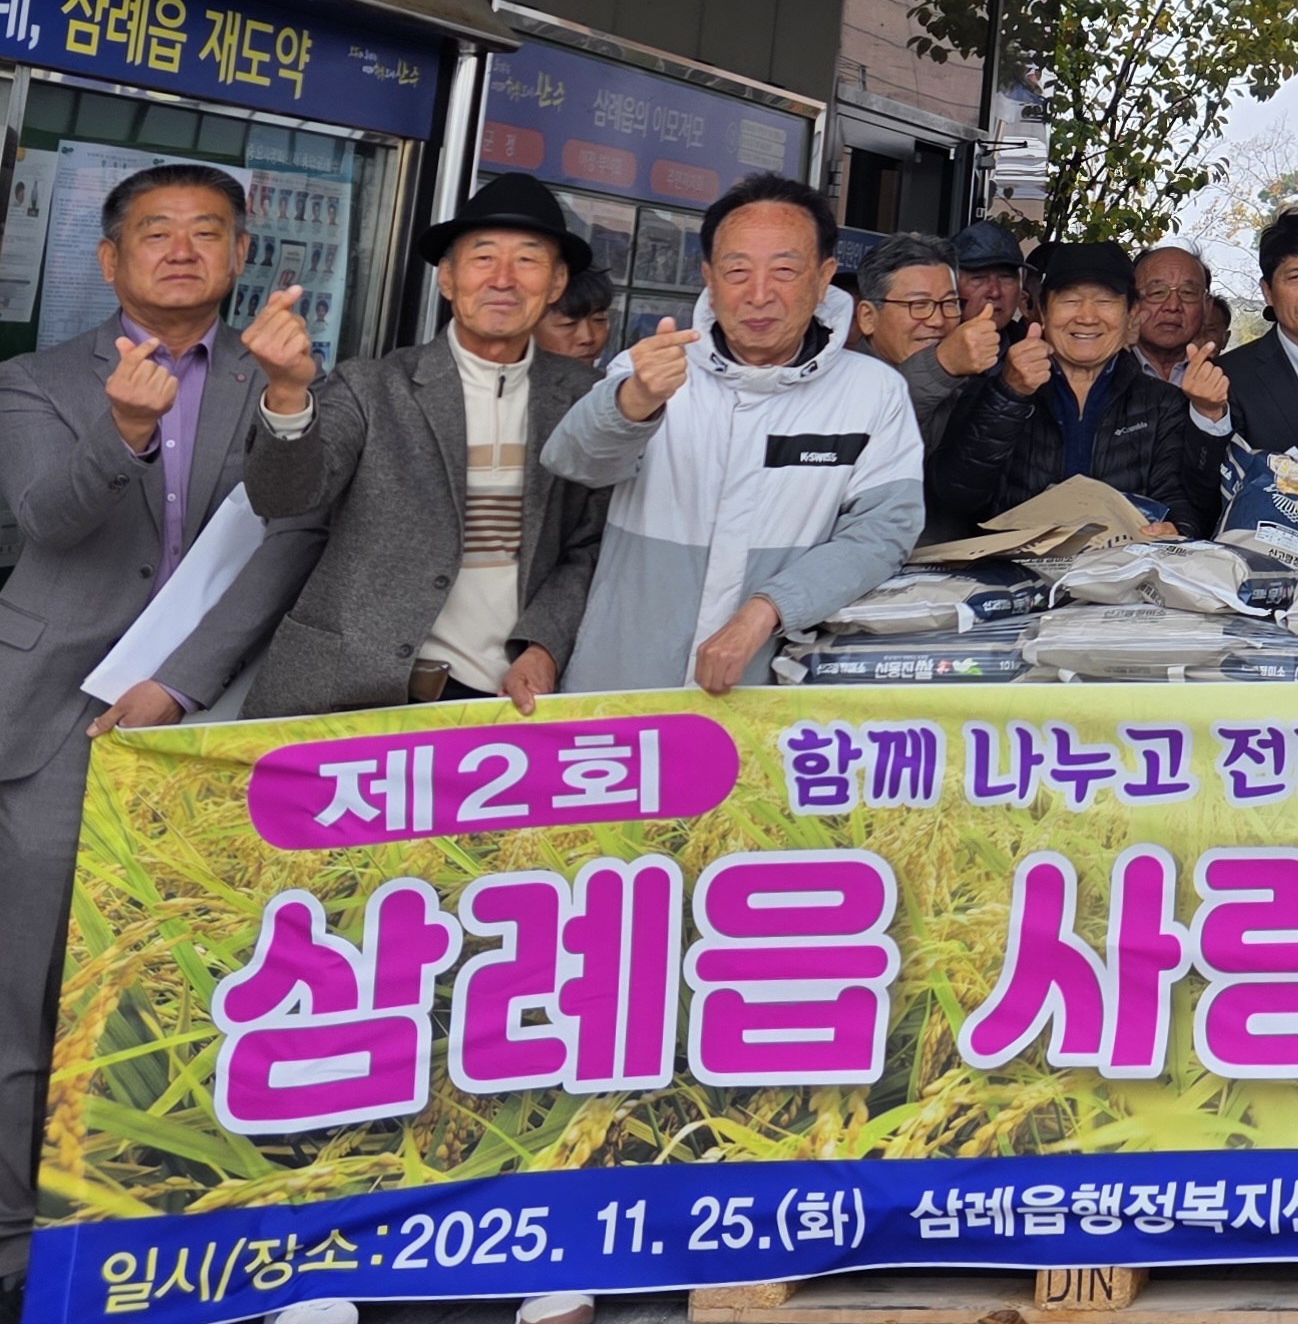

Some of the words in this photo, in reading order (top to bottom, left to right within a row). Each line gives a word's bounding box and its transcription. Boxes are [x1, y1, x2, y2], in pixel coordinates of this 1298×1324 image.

[199, 8, 313, 101] 재도약
[593, 88, 650, 138] 삼례읍의
[652, 105, 706, 149] 이모저모
[786, 726, 937, 807] 함께
[970, 726, 1190, 803] 나누고
[221, 856, 893, 1124] 삼례읍
[597, 1199, 664, 1255] 11.
[1046, 1268, 1114, 1304] DIN
